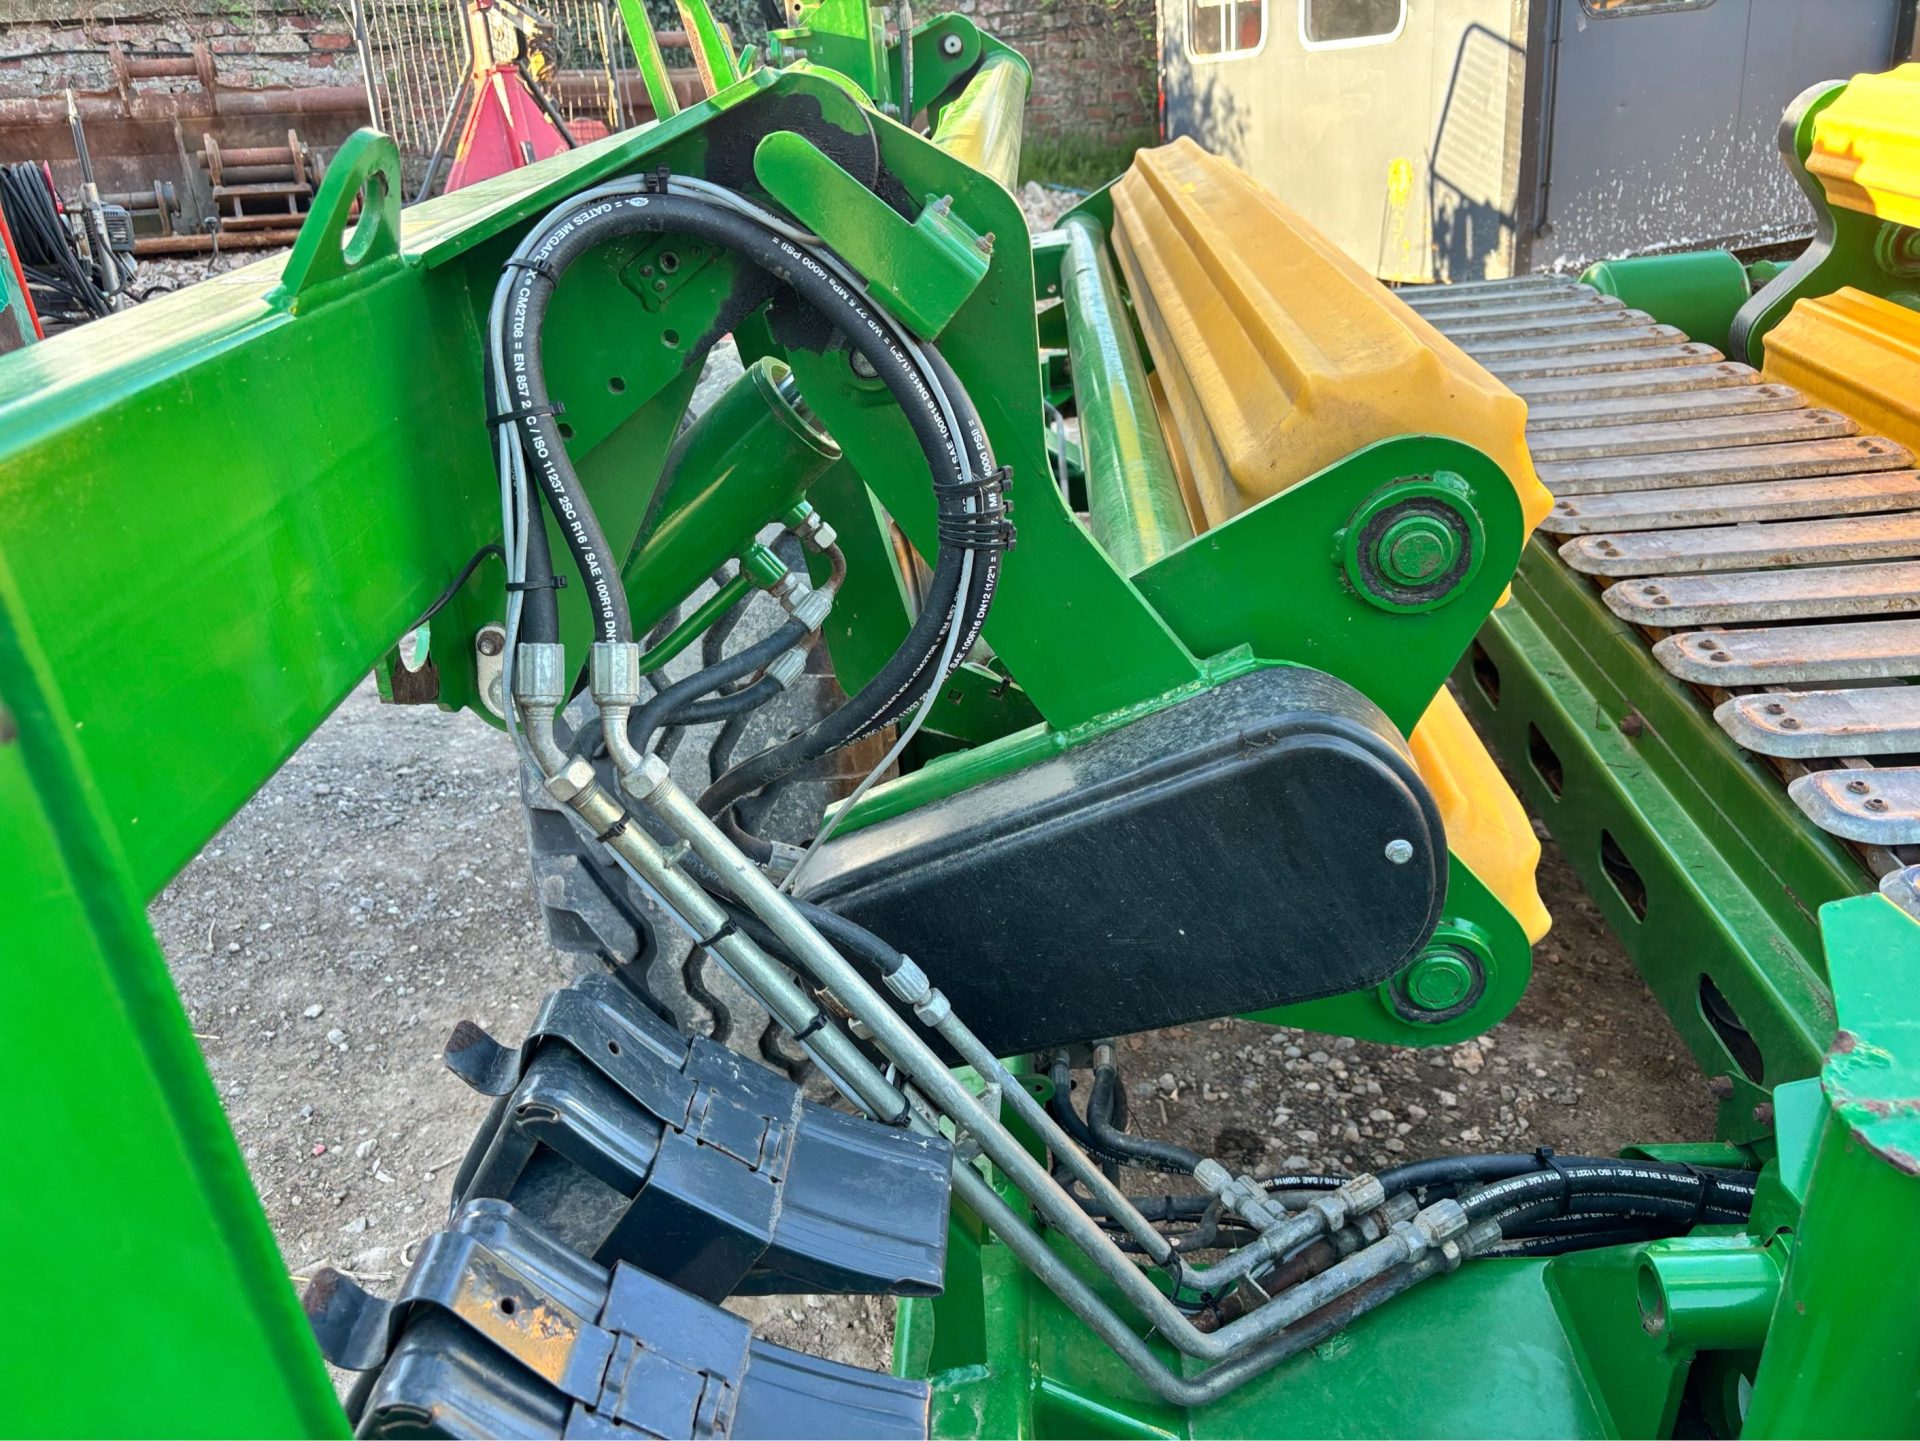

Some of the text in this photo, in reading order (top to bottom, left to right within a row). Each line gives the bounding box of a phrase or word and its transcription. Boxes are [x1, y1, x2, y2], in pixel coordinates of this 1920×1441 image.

[573, 203, 612, 225] GATES
[525, 222, 575, 286] MEGAFLX®
[780, 242, 802, 260] PSI)
[802, 257, 828, 280] (4000
[828, 278, 849, 300] MPa
[513, 287, 530, 338] CM2T08
[867, 320, 883, 337] WP
[514, 354, 525, 370] EN
[516, 374, 530, 397] 857
[909, 371, 930, 401] DN12
[521, 400, 537, 425] 2C
[927, 399, 950, 440] 100R16
[533, 436, 548, 456] ISO
[970, 429, 985, 451] PSI)
[945, 440, 959, 464] SAE
[543, 461, 565, 493] 11237
[558, 495, 577, 520] 2SC
[570, 521, 588, 544] R16
[585, 553, 602, 577] SAE
[594, 578, 614, 620] 100R16
[976, 592, 992, 619] DN12
[962, 620, 982, 651] 100R16
[949, 652, 965, 669] SAE
[1274, 1176, 1300, 1185] 100R16
[1302, 1176, 1318, 1184] SAE
[1324, 1177, 1339, 1186] R16
[1526, 1176, 1542, 1185] SAE
[1547, 1172, 1561, 1181] R16
[1597, 1168, 1612, 1177] ISO
[1619, 1169, 1633, 1177] 2SC
[1635, 1170, 1648, 1178] 857
[1650, 1172, 1661, 1180] EN
[1669, 1175, 1700, 1185] CM2T08
[1484, 1186, 1504, 1199] DN12
[1504, 1179, 1527, 1192] 100R16
